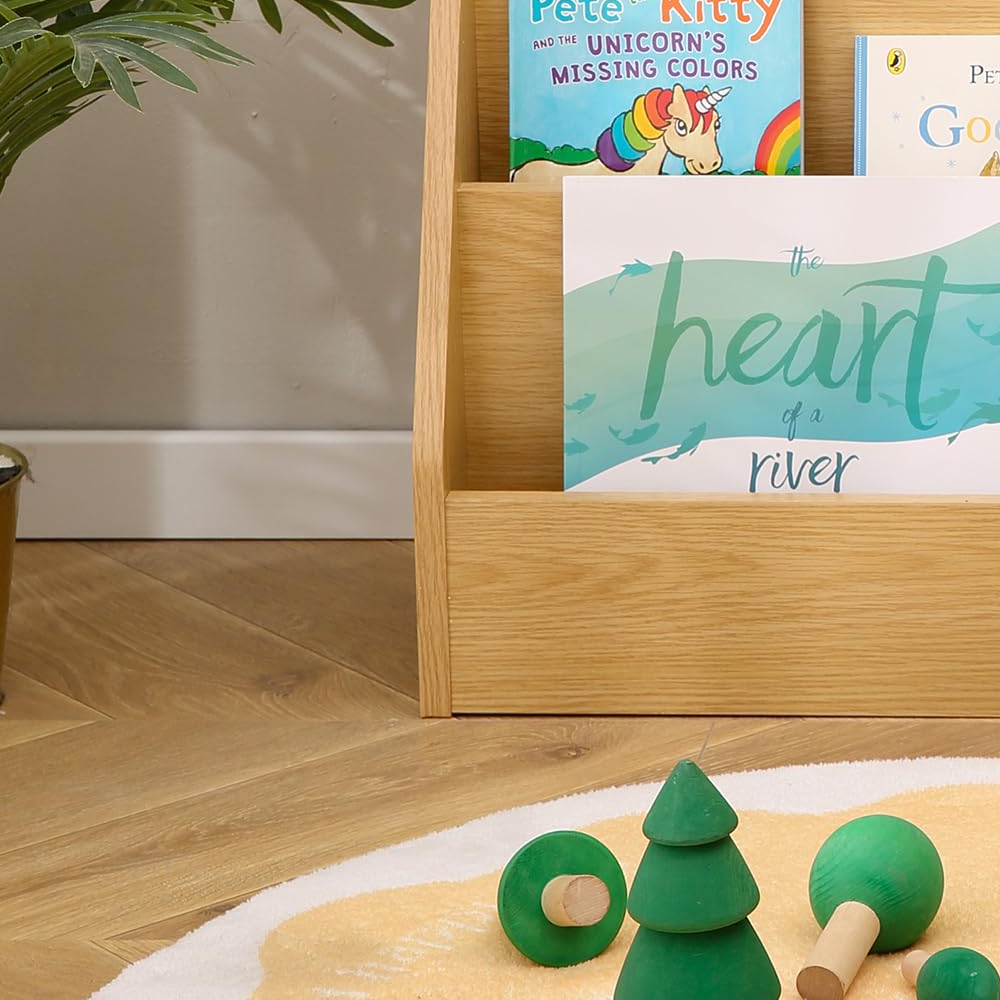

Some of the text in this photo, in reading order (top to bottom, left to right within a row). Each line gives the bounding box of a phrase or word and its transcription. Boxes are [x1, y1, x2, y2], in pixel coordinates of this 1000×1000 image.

[533, 31, 726, 56] AND THE UNICORN'S
[551, 58, 758, 85] MISSING COLORS
[779, 245, 825, 278] the
[781, 401, 824, 441] of a
[748, 451, 860, 493] river
